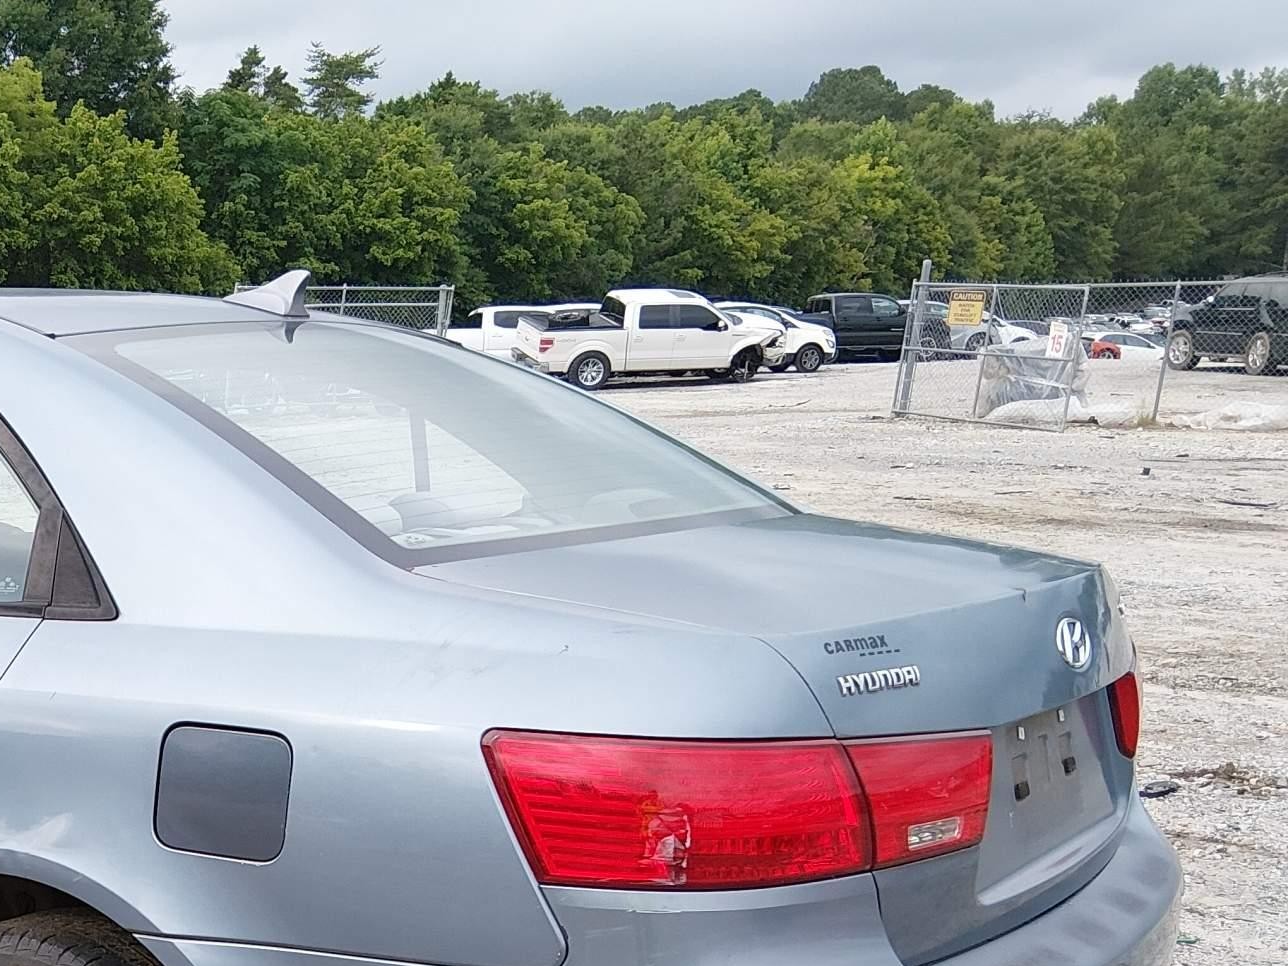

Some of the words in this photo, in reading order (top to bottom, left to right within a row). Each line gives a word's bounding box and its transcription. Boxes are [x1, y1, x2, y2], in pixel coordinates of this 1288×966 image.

[953, 292, 984, 301] CAUTION
[1050, 334, 1064, 354] 15
[837, 665, 921, 697] HYUNDAI
